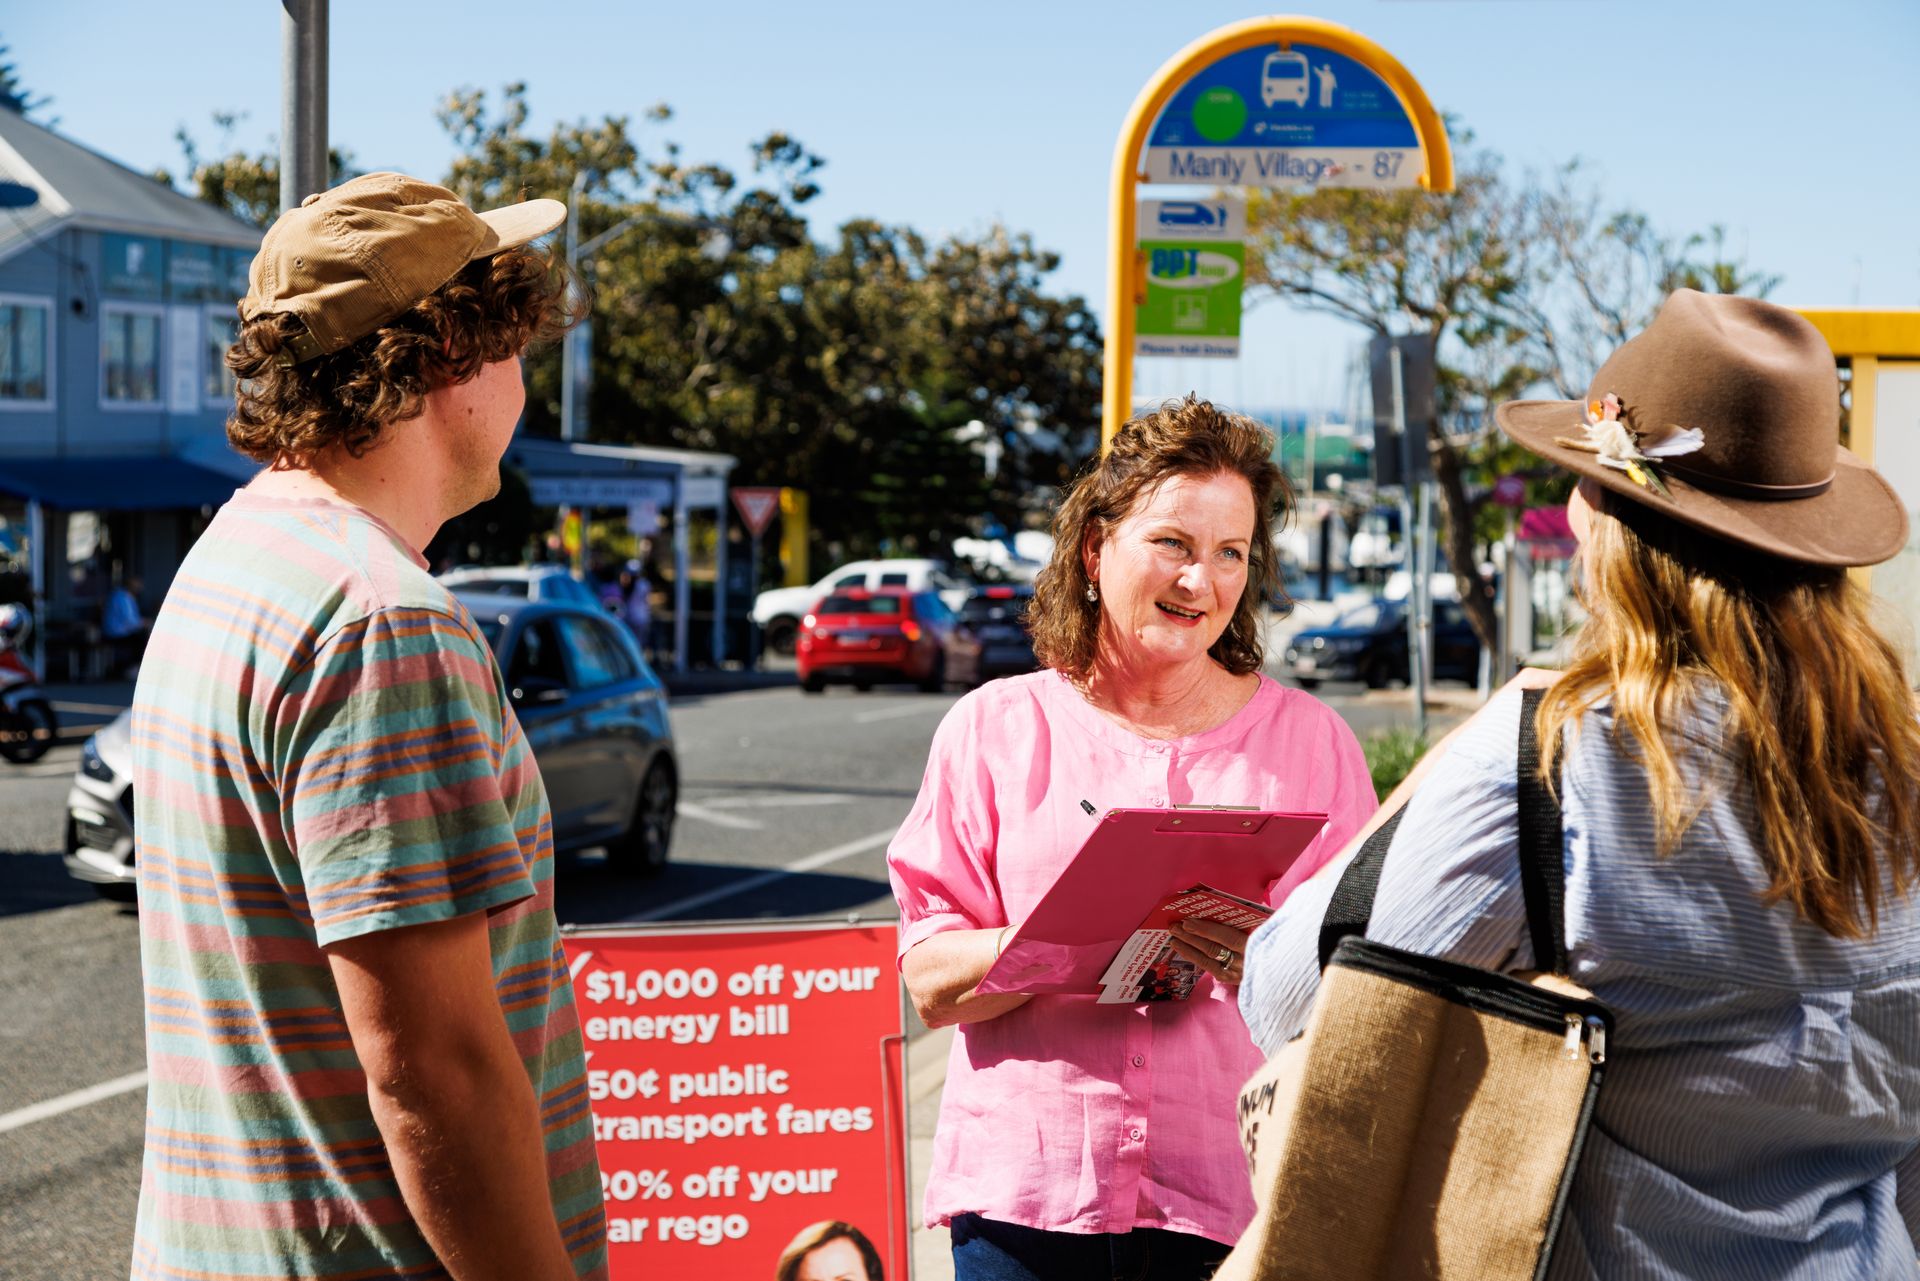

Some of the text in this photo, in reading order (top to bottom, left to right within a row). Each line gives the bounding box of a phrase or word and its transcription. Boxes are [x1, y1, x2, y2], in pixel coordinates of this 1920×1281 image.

[1168, 150, 1246, 185] Manly
[1373, 151, 1404, 178] 87
[585, 964, 880, 1005] $1,000 off your
[585, 1004, 789, 1044] energy bill
[588, 1063, 790, 1104] 50¢ public
[592, 1103, 874, 1144] transport fares
[682, 1165, 741, 1199] off
[747, 1168, 838, 1202] your
[606, 1213, 750, 1246] ar rego
